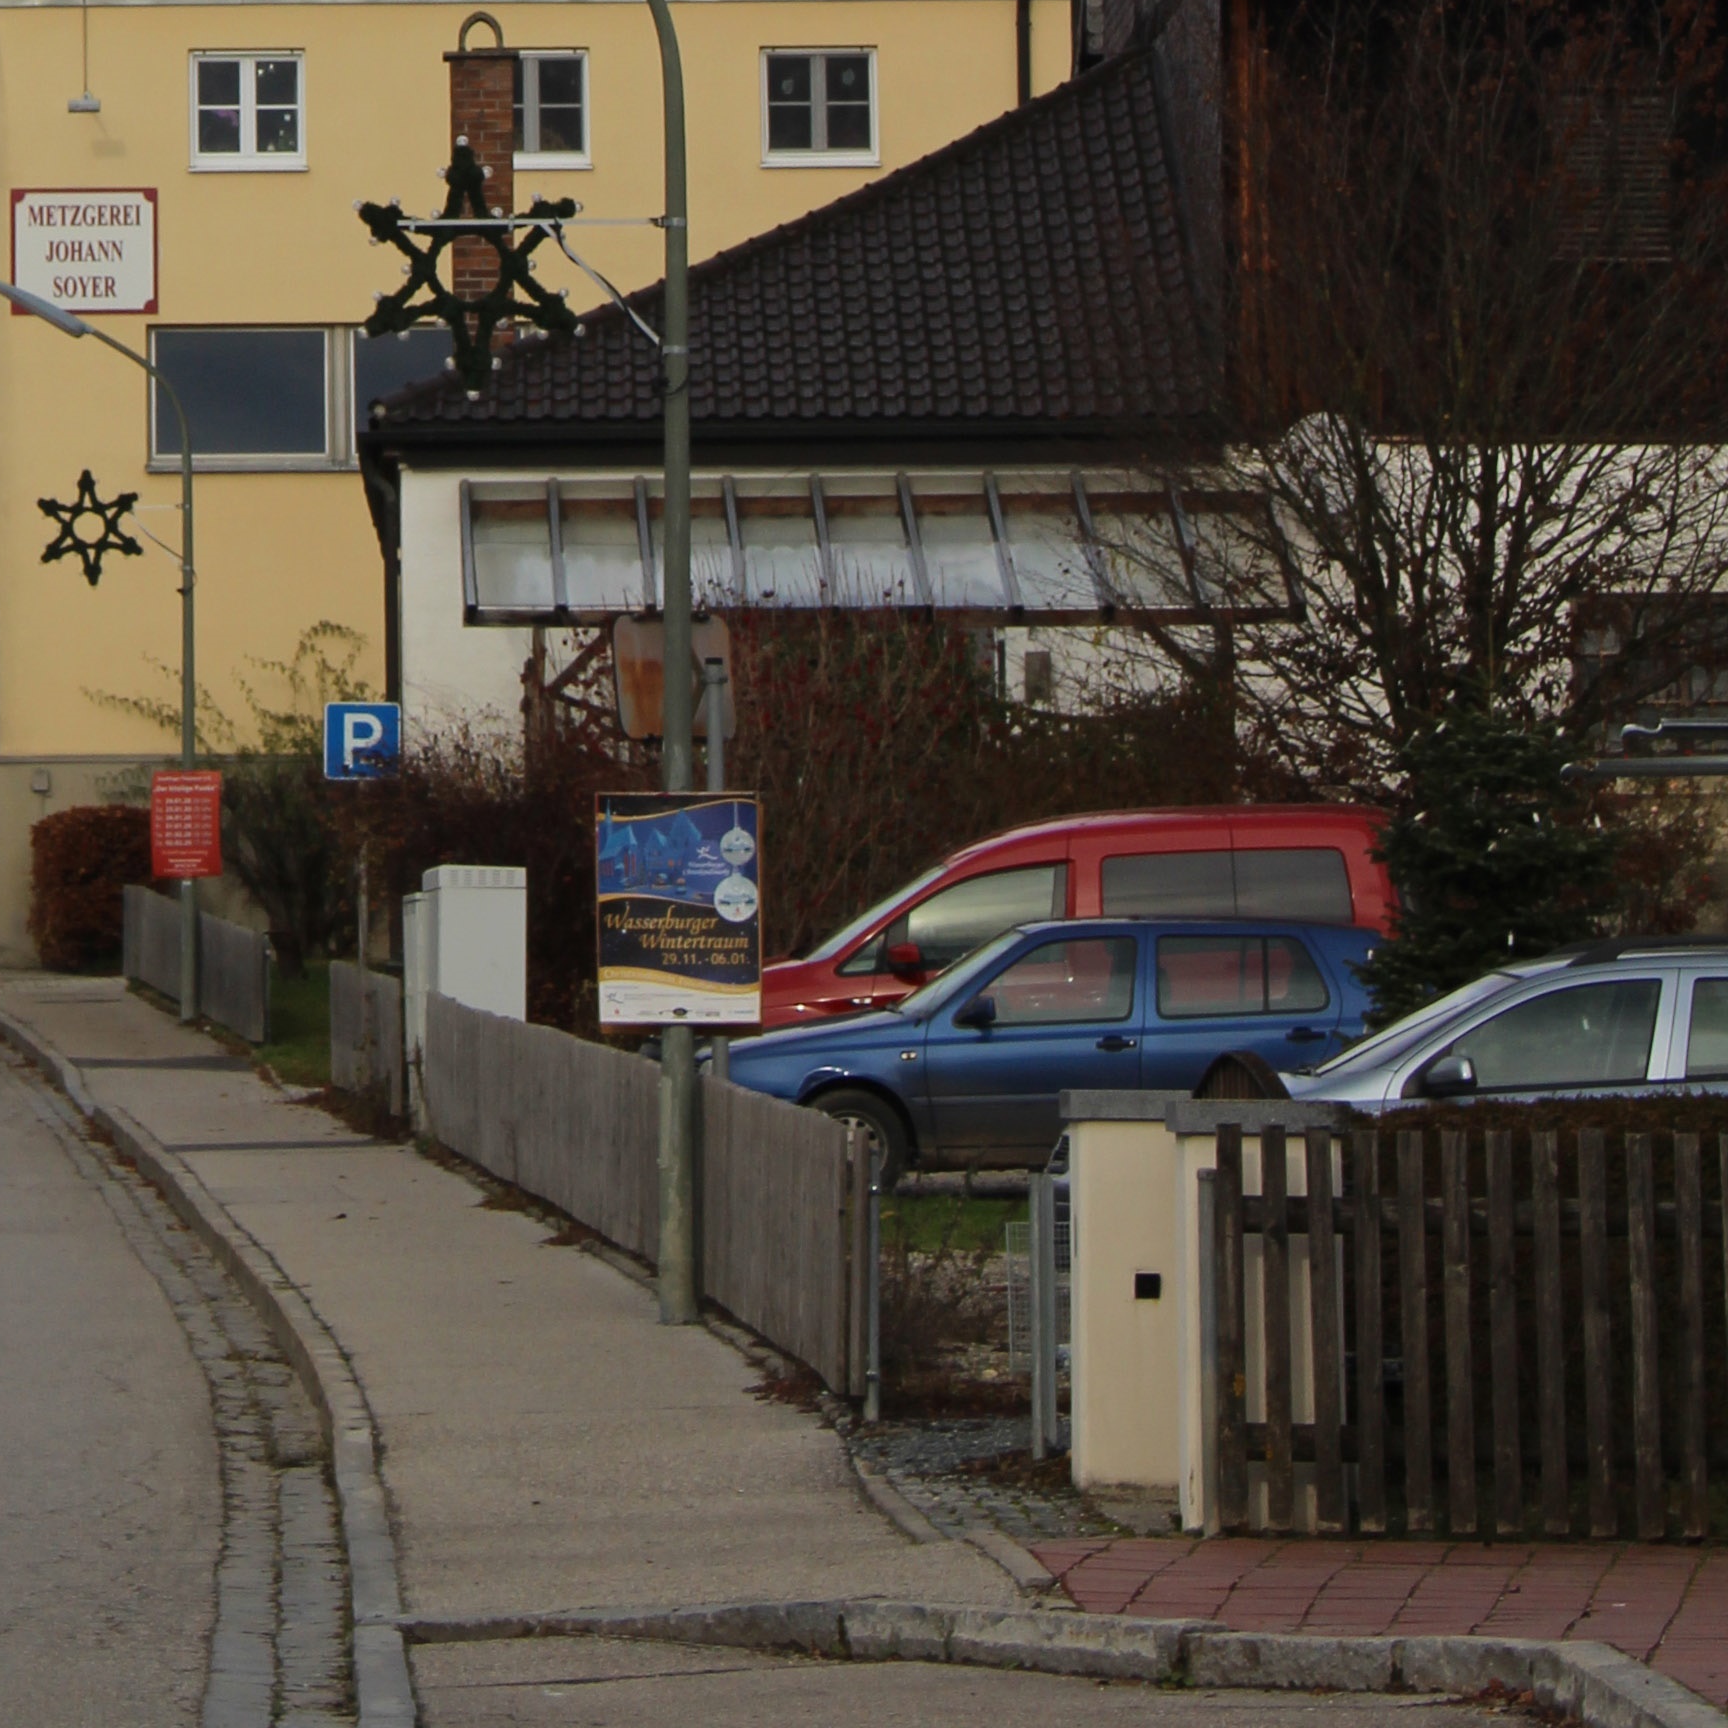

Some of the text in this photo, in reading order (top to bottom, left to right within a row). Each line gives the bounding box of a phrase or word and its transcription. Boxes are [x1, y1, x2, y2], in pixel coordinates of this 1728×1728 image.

[28, 204, 141, 227] METZGEREI
[45, 240, 123, 263] JOHANN
[53, 276, 117, 298] SOYER
[344, 712, 383, 769] P
[604, 904, 719, 934] Wasserburger
[639, 932, 749, 949] Wintertraum
